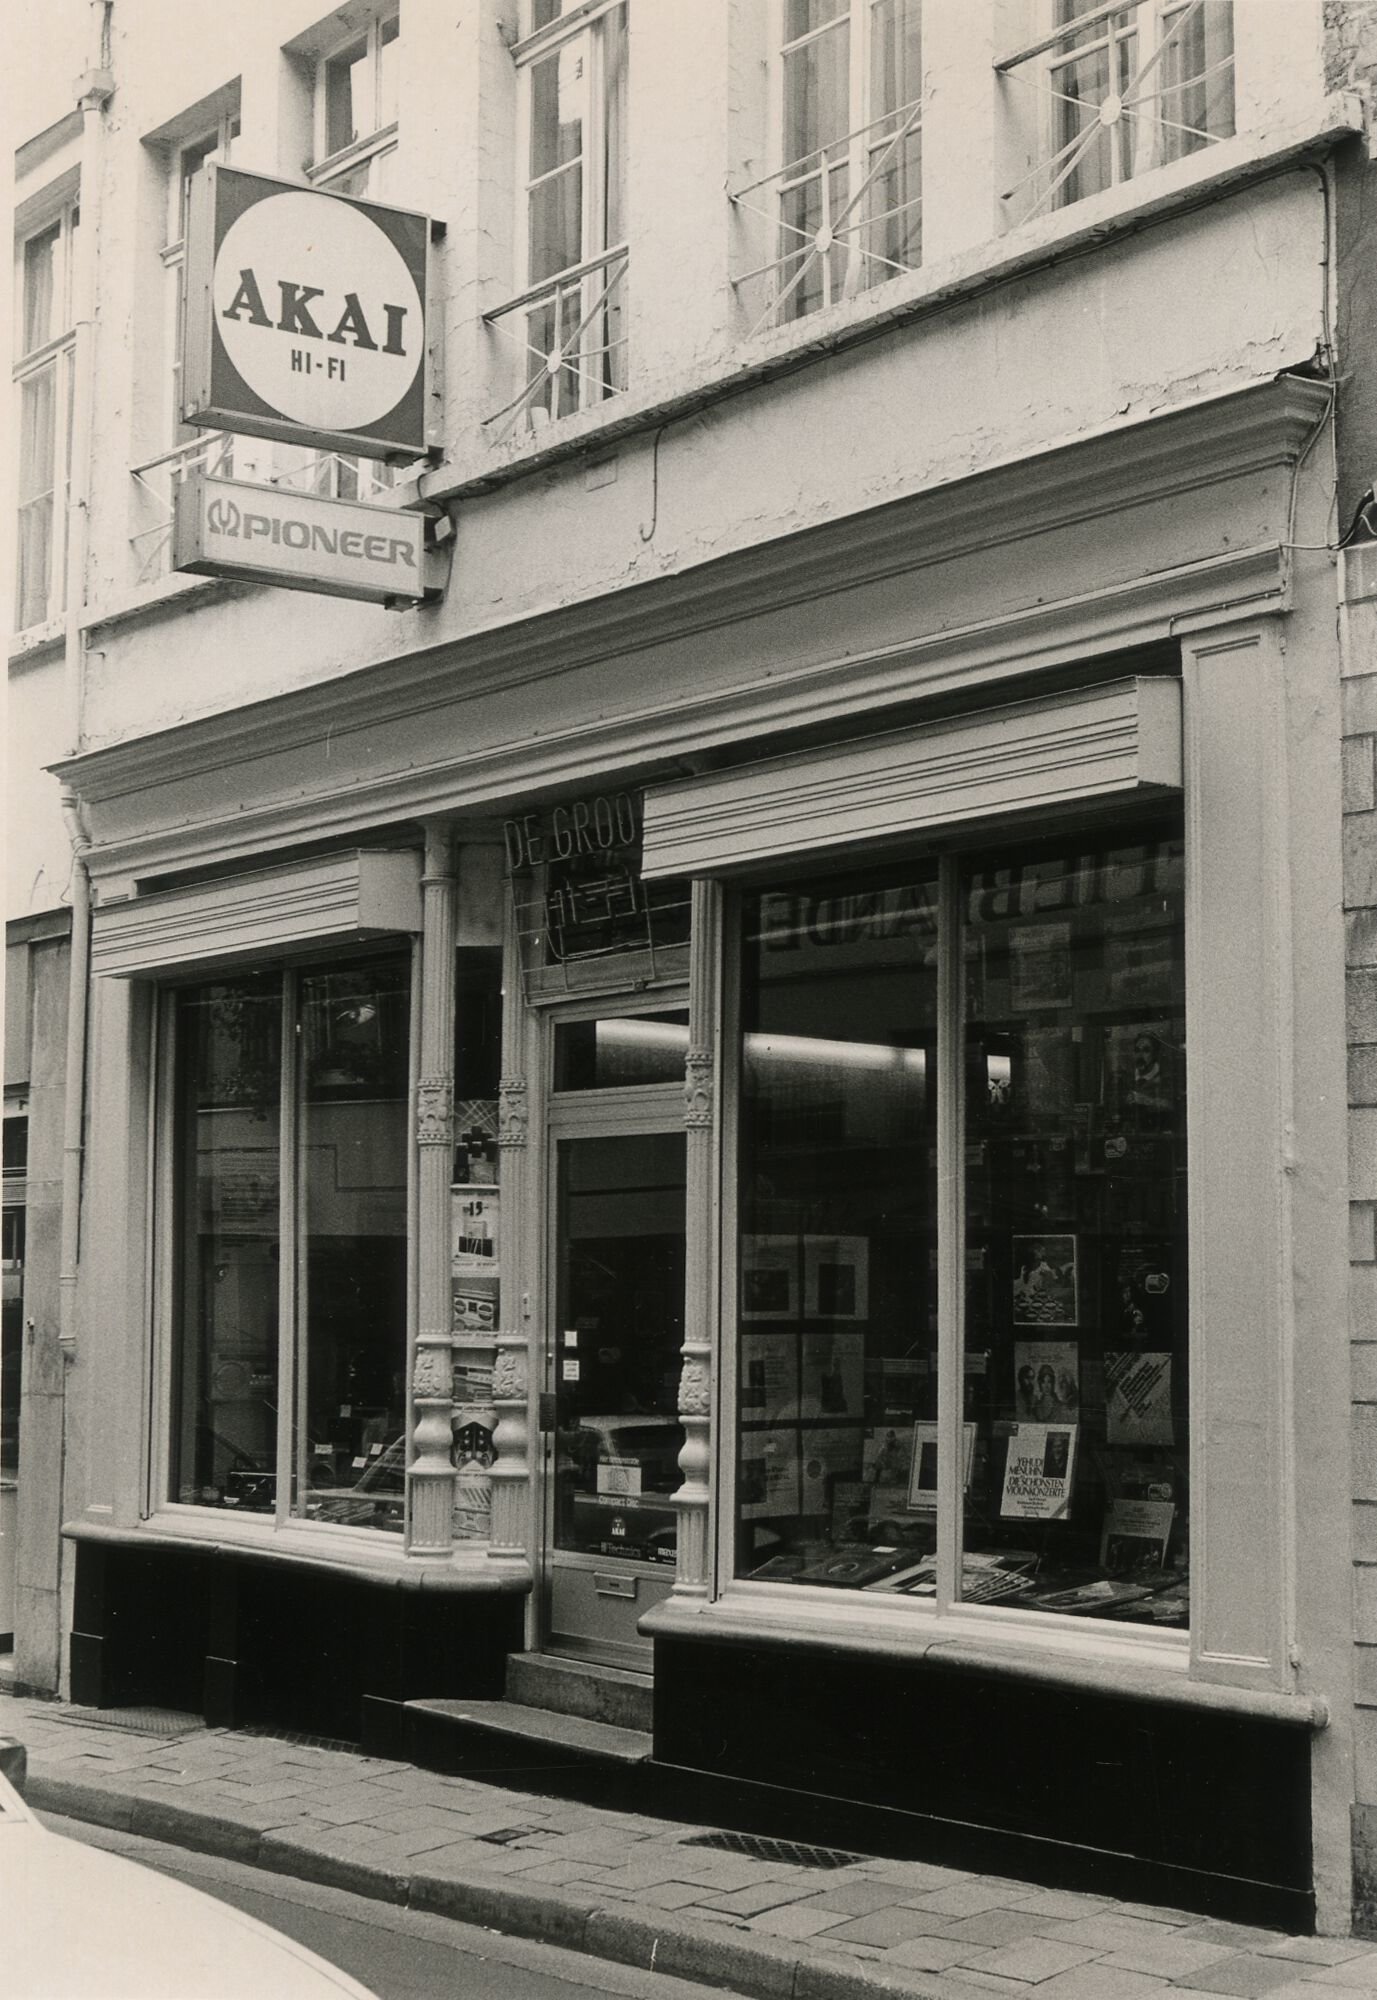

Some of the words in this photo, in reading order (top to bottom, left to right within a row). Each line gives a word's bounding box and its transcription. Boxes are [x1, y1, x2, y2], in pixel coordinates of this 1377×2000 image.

[222, 268, 408, 357] AKAI
[290, 349, 346, 382] HI-FI
[242, 512, 417, 568] PIONEER
[503, 815, 544, 869] DE
[1009, 1466, 1042, 1476] MENUHIN
[1017, 1457, 1043, 1467] YEHUDI
